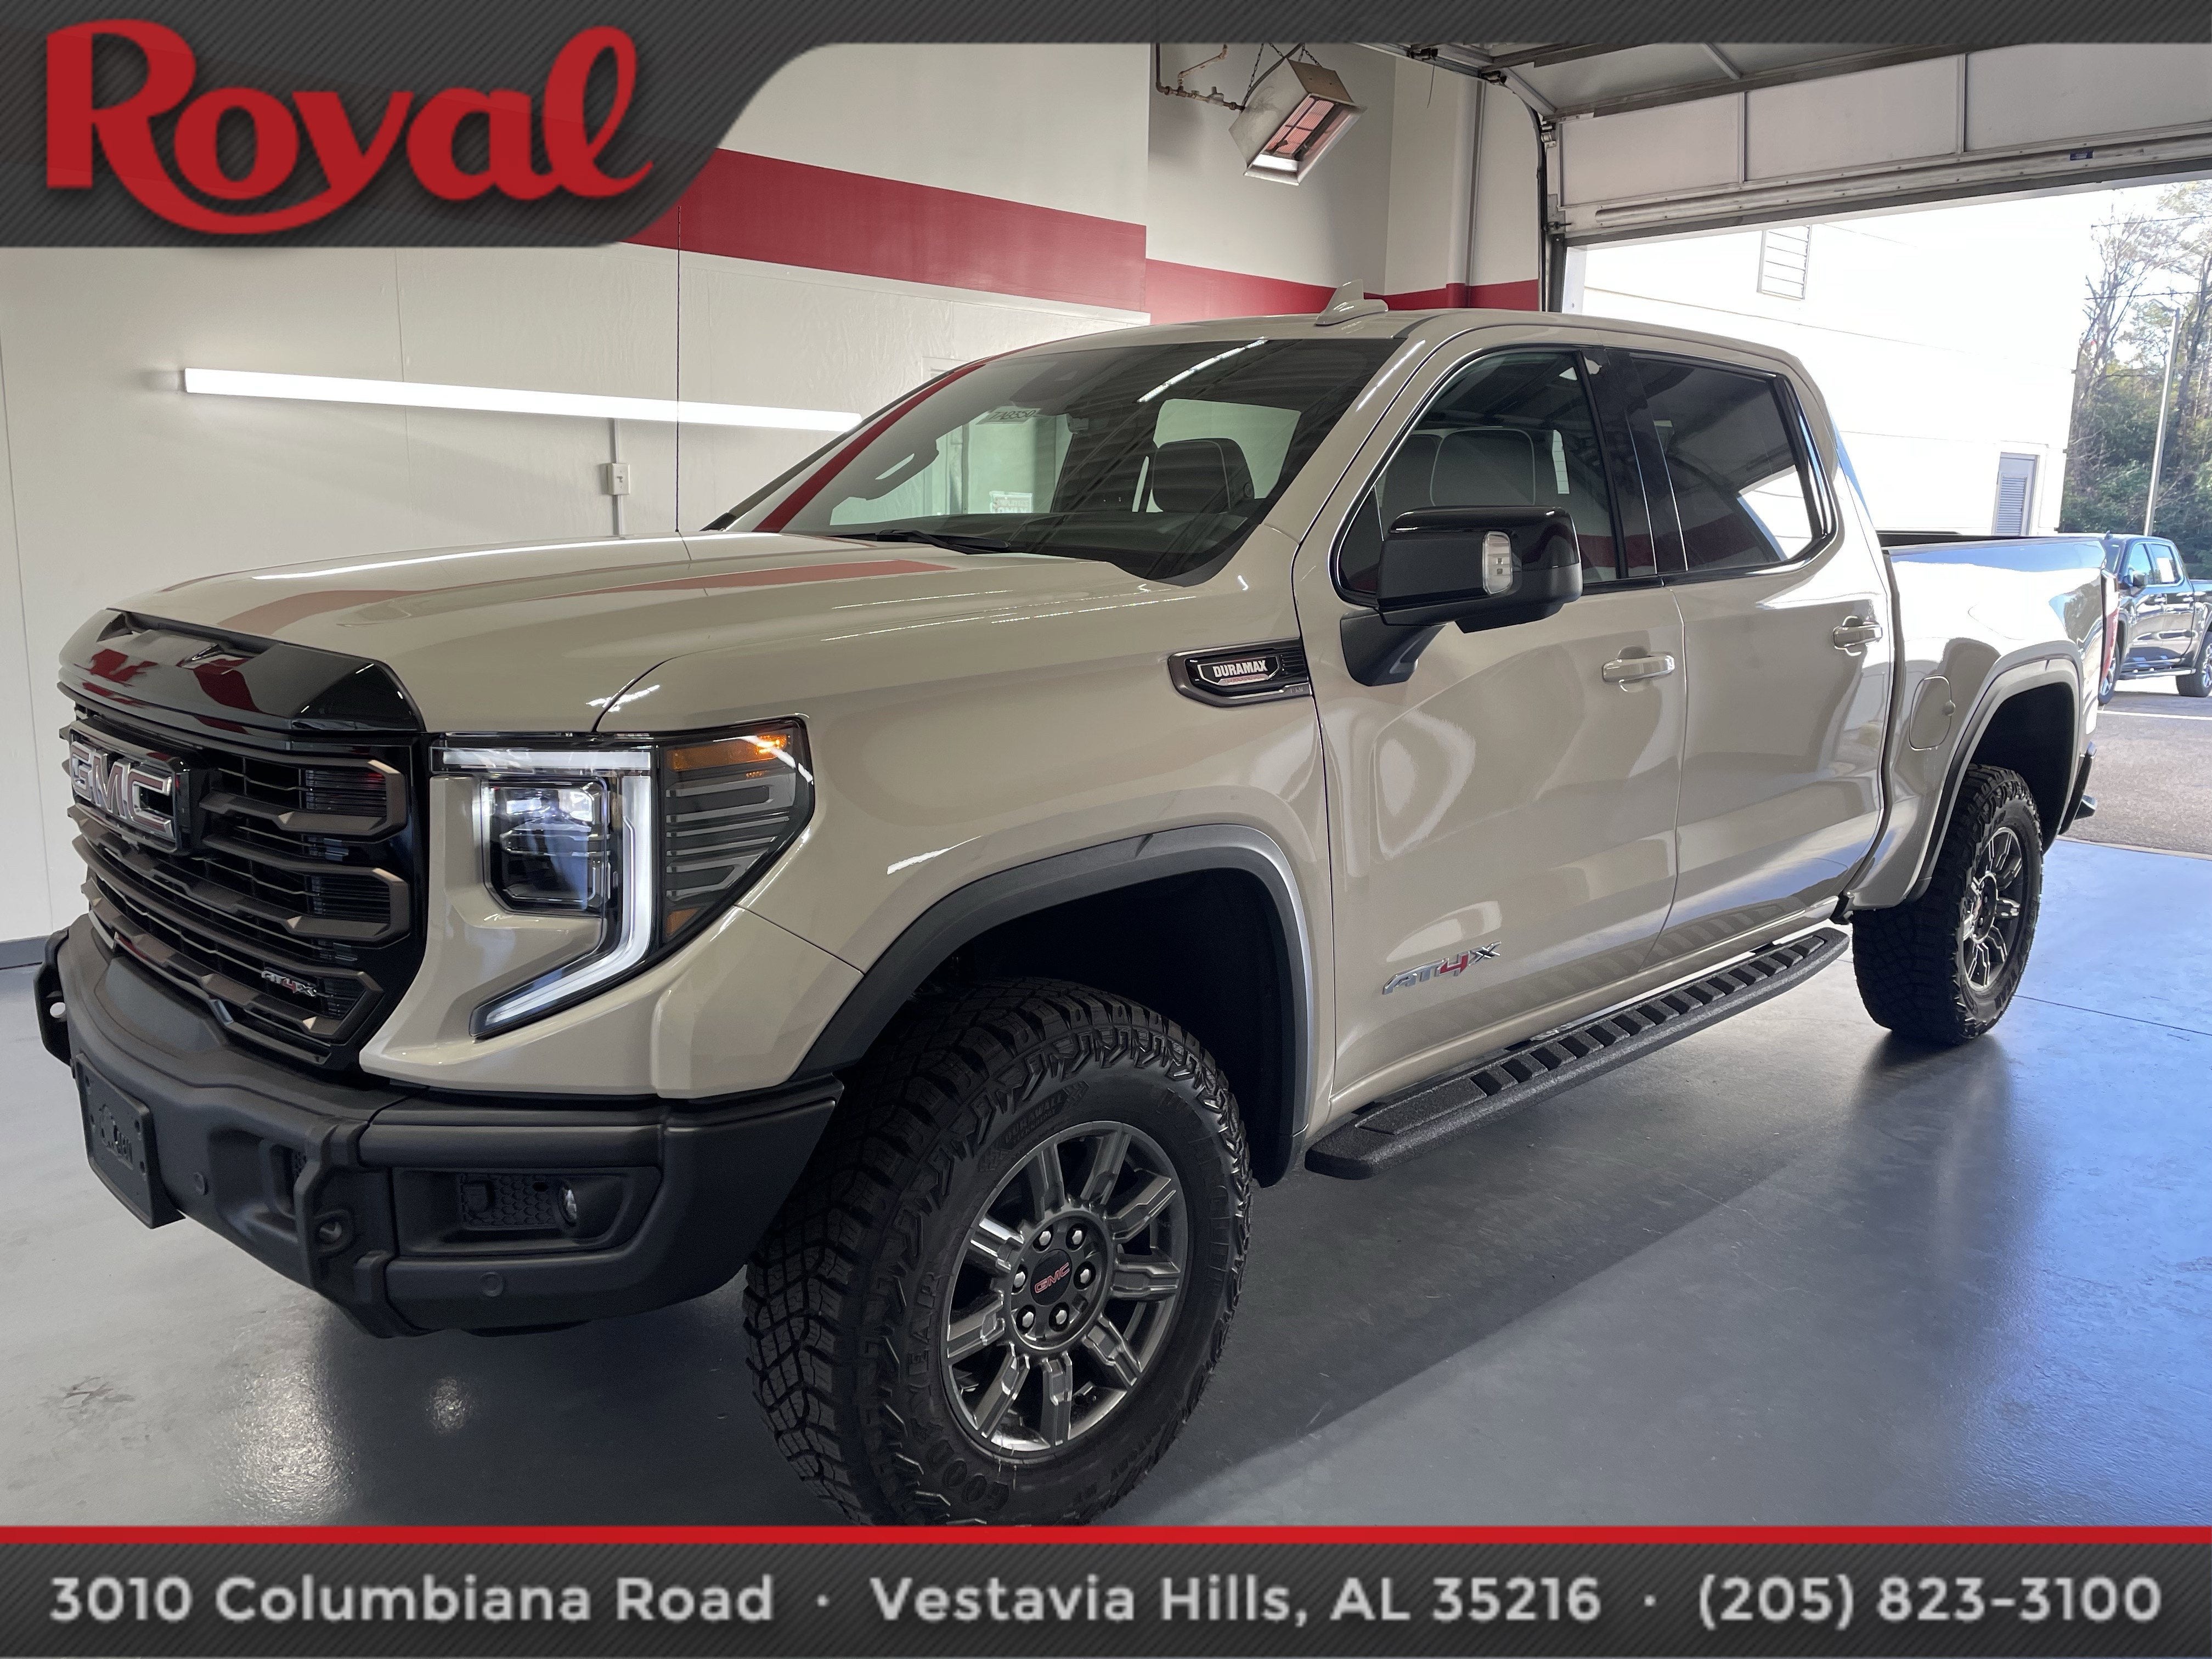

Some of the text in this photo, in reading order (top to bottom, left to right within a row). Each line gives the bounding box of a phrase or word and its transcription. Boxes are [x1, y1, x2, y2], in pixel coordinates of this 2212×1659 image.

[1211, 660, 1268, 678] DURAMAX
[69, 741, 175, 841] GMC
[1382, 940, 1502, 995] AT4X
[1034, 1262, 1070, 1294] GMC
